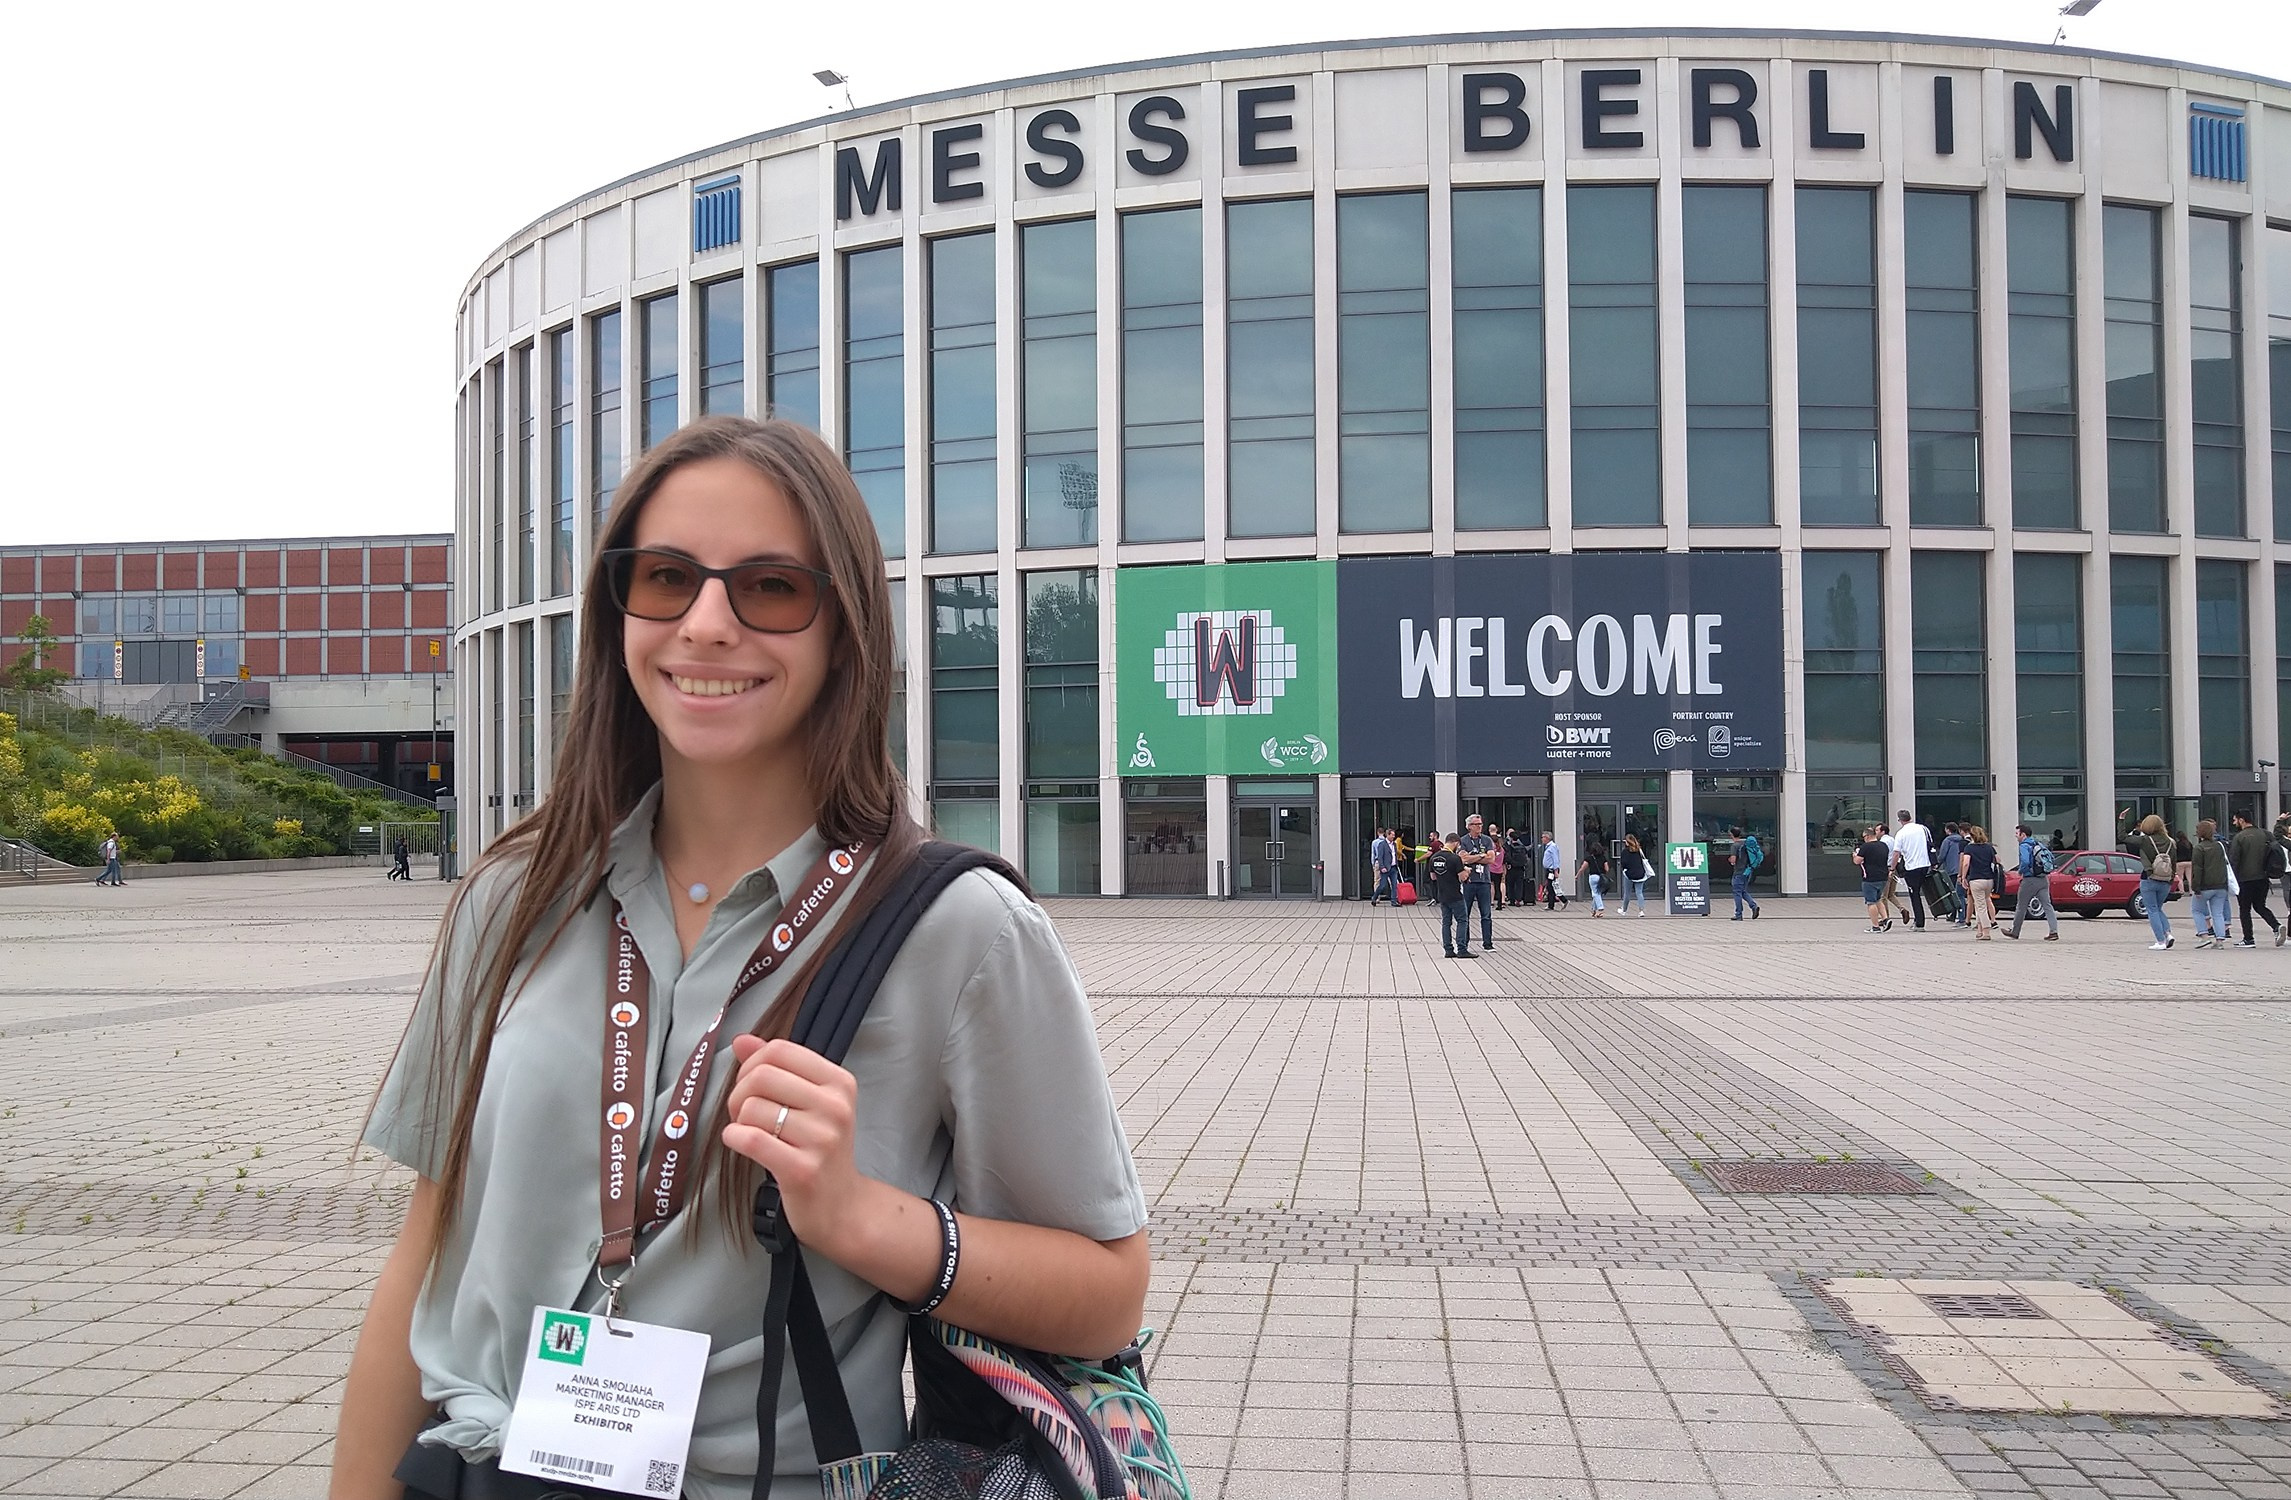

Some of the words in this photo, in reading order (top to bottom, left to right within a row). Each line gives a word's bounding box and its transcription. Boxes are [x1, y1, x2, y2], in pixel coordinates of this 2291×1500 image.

[836, 84, 1298, 221] MESSE
[1462, 67, 2075, 163] BERLIN
[1194, 615, 1257, 707] W
[1399, 613, 1723, 699] WELCOME
[1554, 712, 1571, 721] HOST
[1573, 712, 1602, 721] SPONSOR
[1672, 711, 1702, 720] PORTRAIT
[1704, 711, 1734, 720] COUNTRY
[1565, 727, 1611, 744] BWT
[1279, 746, 1308, 756] WCC
[1382, 778, 1391, 788] C
[1503, 776, 1512, 787] C
[2254, 772, 2260, 782] B
[1680, 848, 1695, 867] W
[793, 877, 834, 927] cafetto
[617, 934, 636, 993] cafetto
[613, 1031, 631, 1092] cafetto
[681, 1041, 708, 1106] cafetto
[610, 1134, 626, 1199] cafetto
[654, 1150, 678, 1217] cafetto
[947, 1221, 957, 1249] SHIT
[941, 1250, 957, 1290] TODAY
[555, 1324, 576, 1352] W
[555, 1383, 613, 1402] MARKETING
[615, 1393, 665, 1411] MANAGER
[571, 1374, 600, 1387] ANNA
[601, 1379, 653, 1397] SMOLIAHA
[574, 1399, 596, 1410] ISPE
[597, 1403, 620, 1415] ARIS
[622, 1407, 641, 1419] LTD
[574, 1413, 633, 1433] EXHIBITOR
